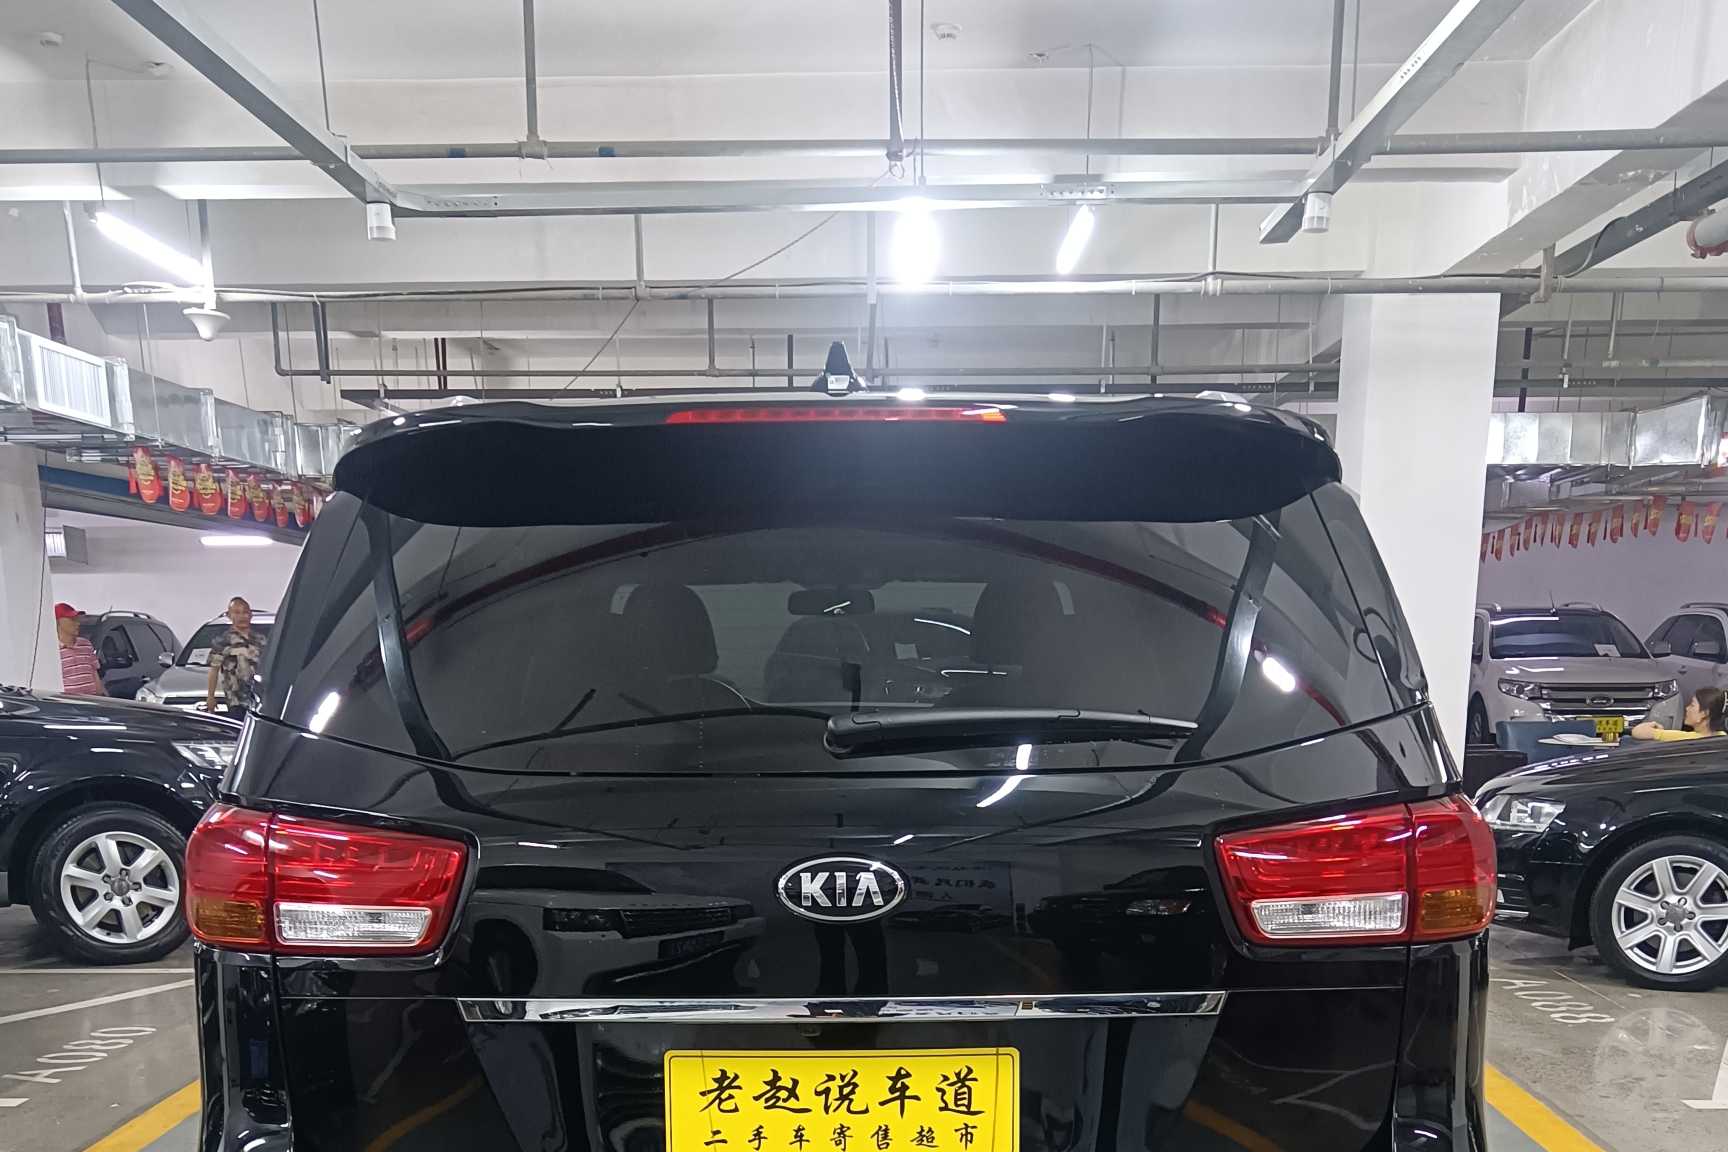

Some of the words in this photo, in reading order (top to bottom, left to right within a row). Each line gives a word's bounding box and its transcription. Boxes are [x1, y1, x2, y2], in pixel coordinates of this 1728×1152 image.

[799, 871, 885, 908] KIA
[1489, 978, 1617, 1024] A088
[1, 1026, 158, 1084] A080
[698, 1064, 985, 1119] 老赵说车道
[703, 1122, 979, 1152] 二手车寄售超市
